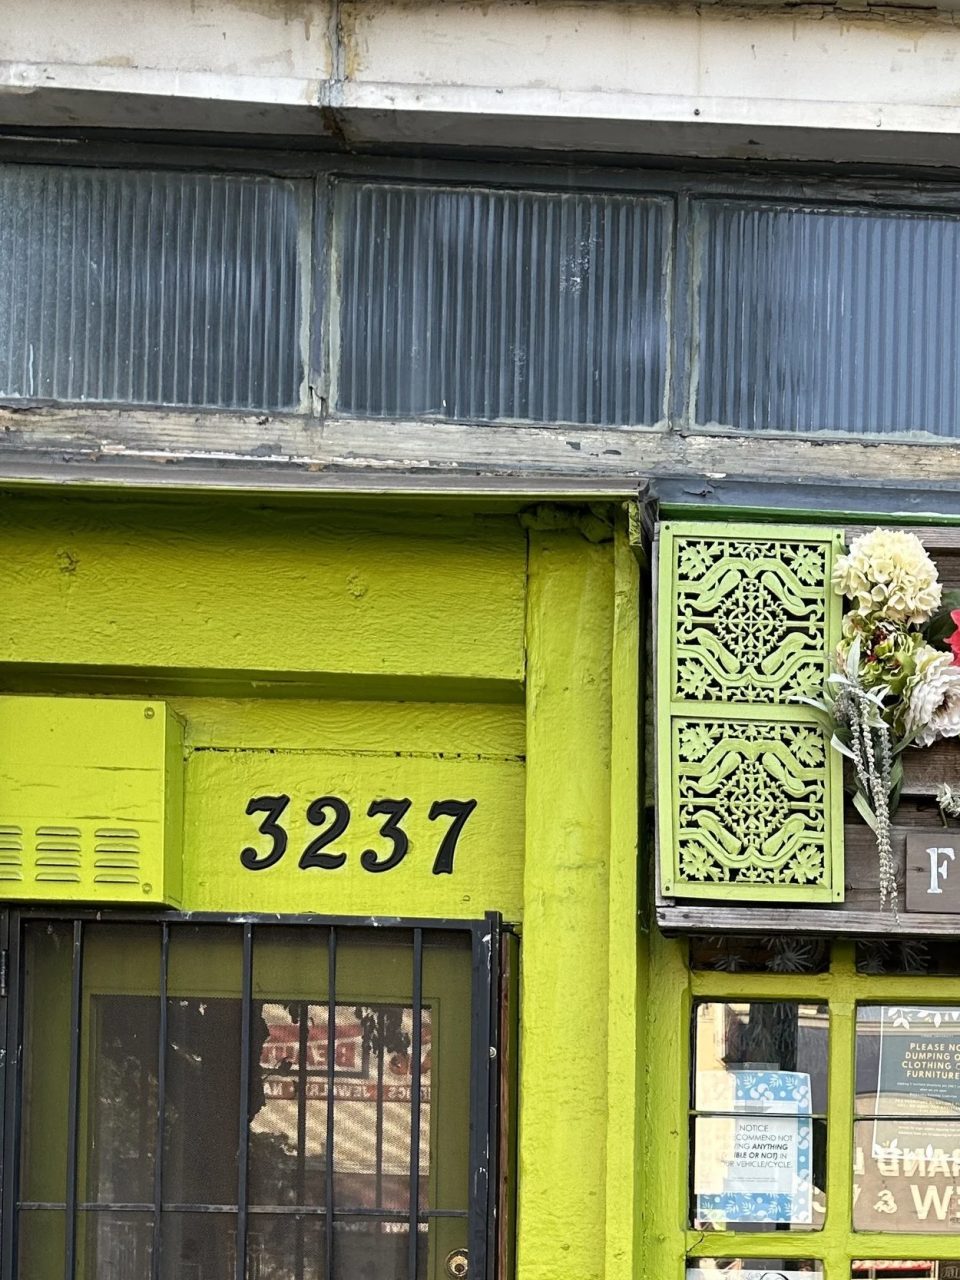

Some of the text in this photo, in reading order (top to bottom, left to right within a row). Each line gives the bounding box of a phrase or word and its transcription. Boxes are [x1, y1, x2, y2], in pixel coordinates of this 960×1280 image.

[240, 794, 478, 876] 3237
[910, 1043, 945, 1051] PLEASE
[905, 1052, 951, 1060] DUMPING
[902, 1061, 952, 1069] CLOTHING
[906, 1070, 960, 1080] FURNITURE
[739, 1124, 769, 1132] NOTICE
[777, 1134, 793, 1142] NOT
[752, 1143, 788, 1151] ANYTHING
